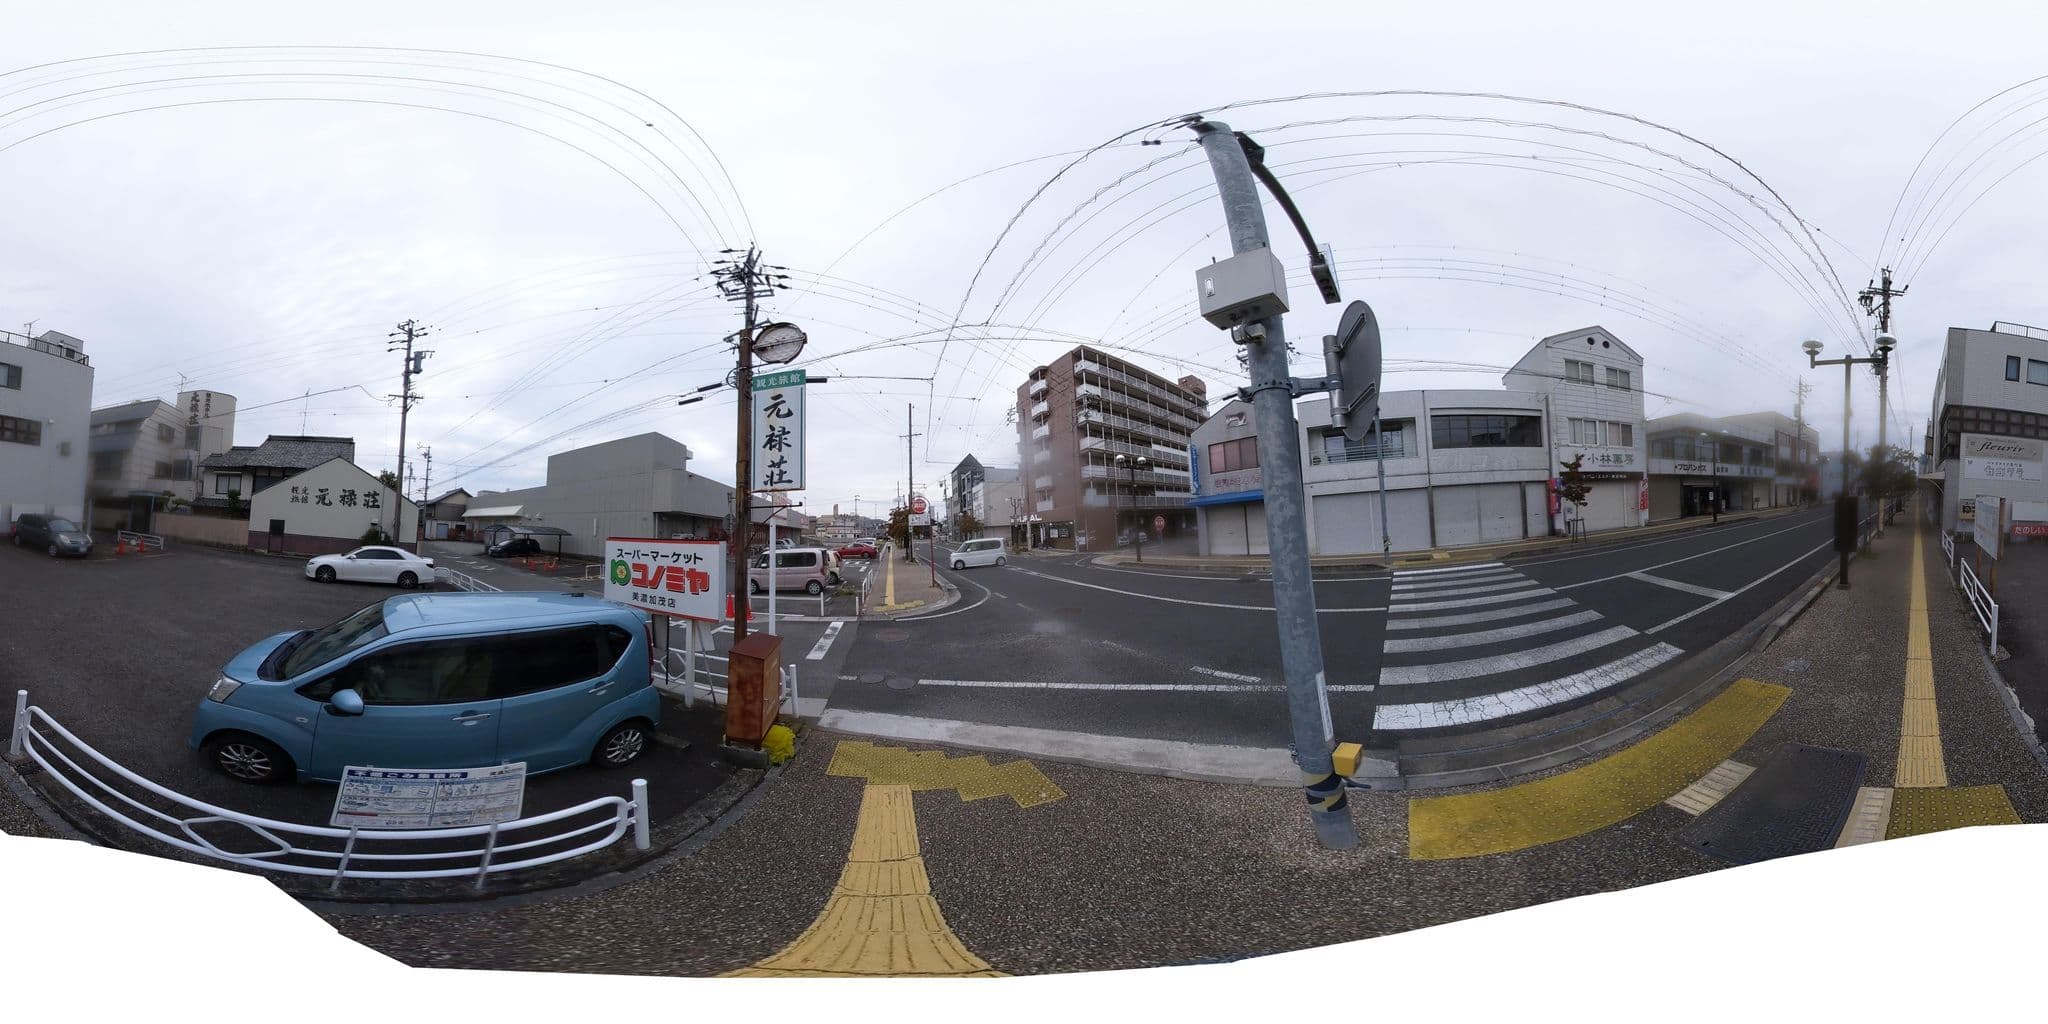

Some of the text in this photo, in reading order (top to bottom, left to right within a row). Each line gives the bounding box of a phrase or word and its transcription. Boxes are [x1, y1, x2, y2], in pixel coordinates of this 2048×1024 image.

[757, 374, 801, 388] 観光旅館
[762, 394, 794, 487] 元禄荘
[1678, 463, 1707, 472] プロパンガス
[316, 488, 380, 509] 元禄荘
[617, 548, 704, 564] スーパーマーケット
[632, 562, 710, 595] コノミヤ
[632, 592, 676, 608] 美濃加茂店
